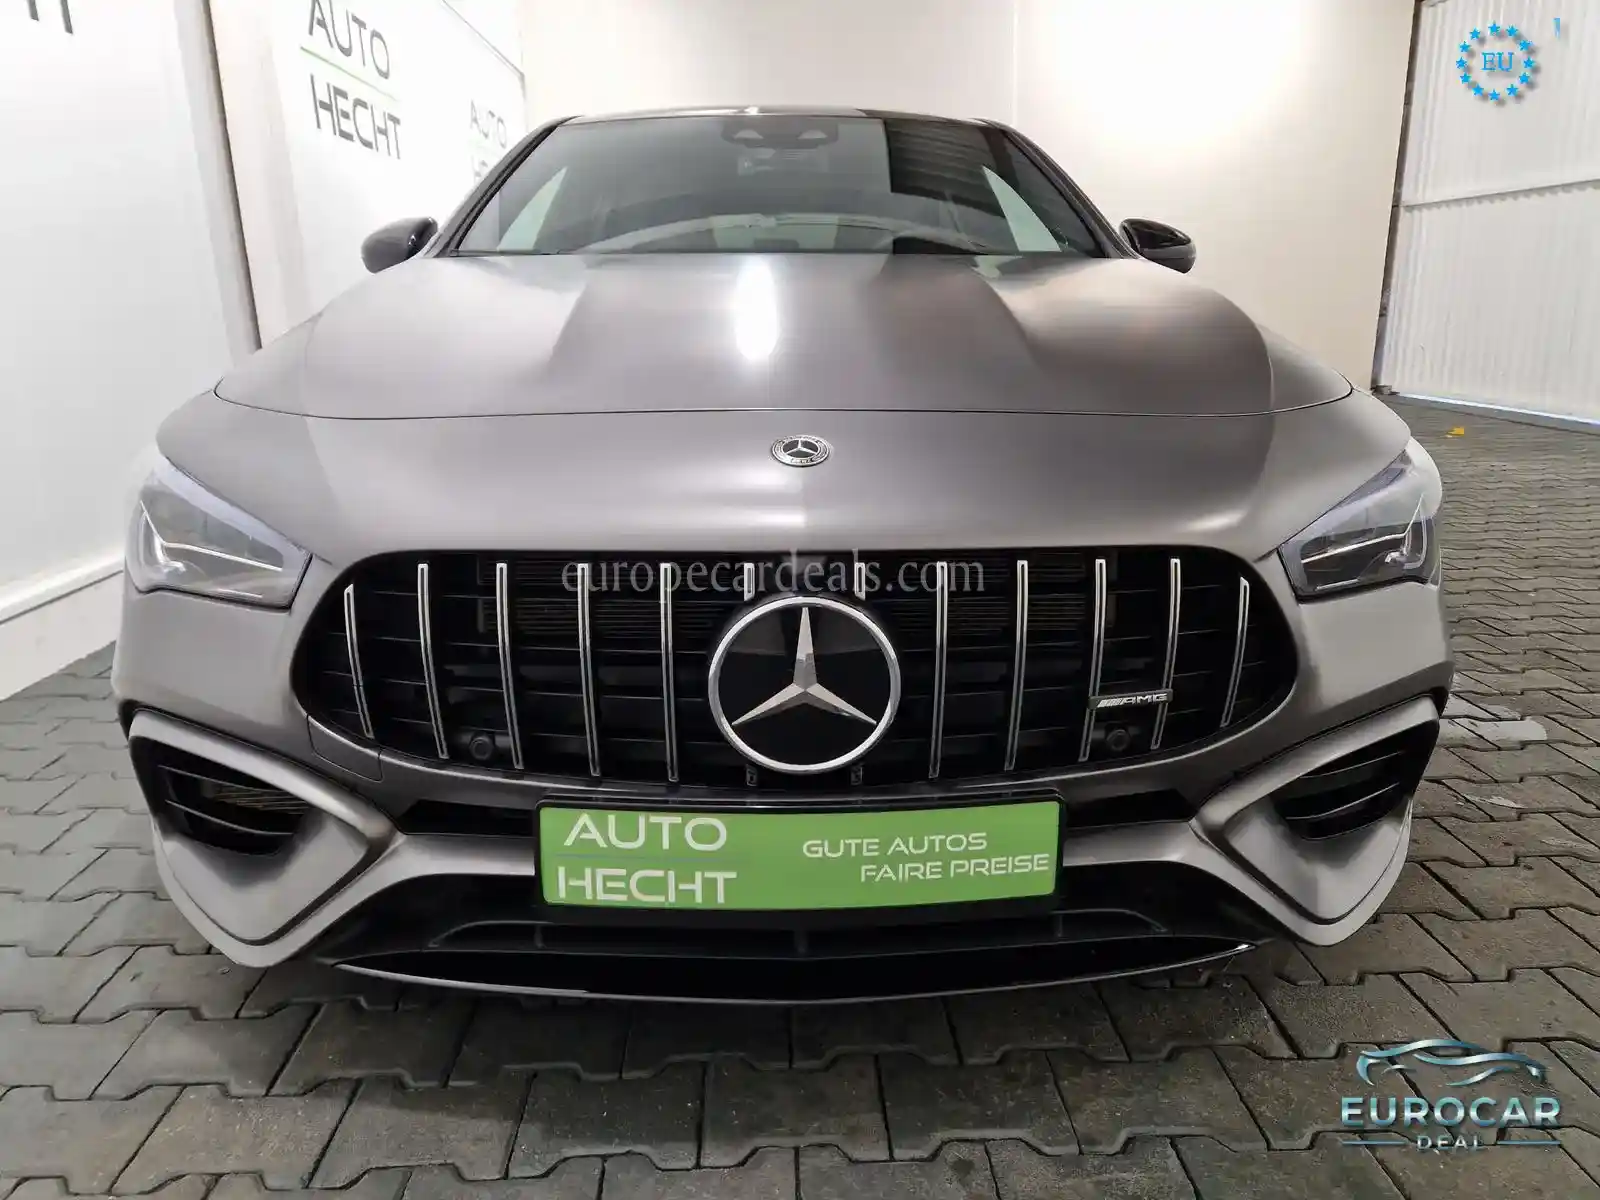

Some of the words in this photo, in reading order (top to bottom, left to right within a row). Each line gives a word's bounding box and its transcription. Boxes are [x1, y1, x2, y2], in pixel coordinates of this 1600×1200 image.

[308, 0, 390, 80] AUTO
[310, 73, 401, 160] HECHT
[1121, 693, 1168, 706] AMG
[563, 813, 727, 851] AUTO
[802, 838, 880, 858] GUTE
[886, 832, 988, 856] AUTOS
[557, 866, 737, 904] HECHT
[860, 861, 943, 883] FAIRE
[950, 853, 1050, 878] PREISE
